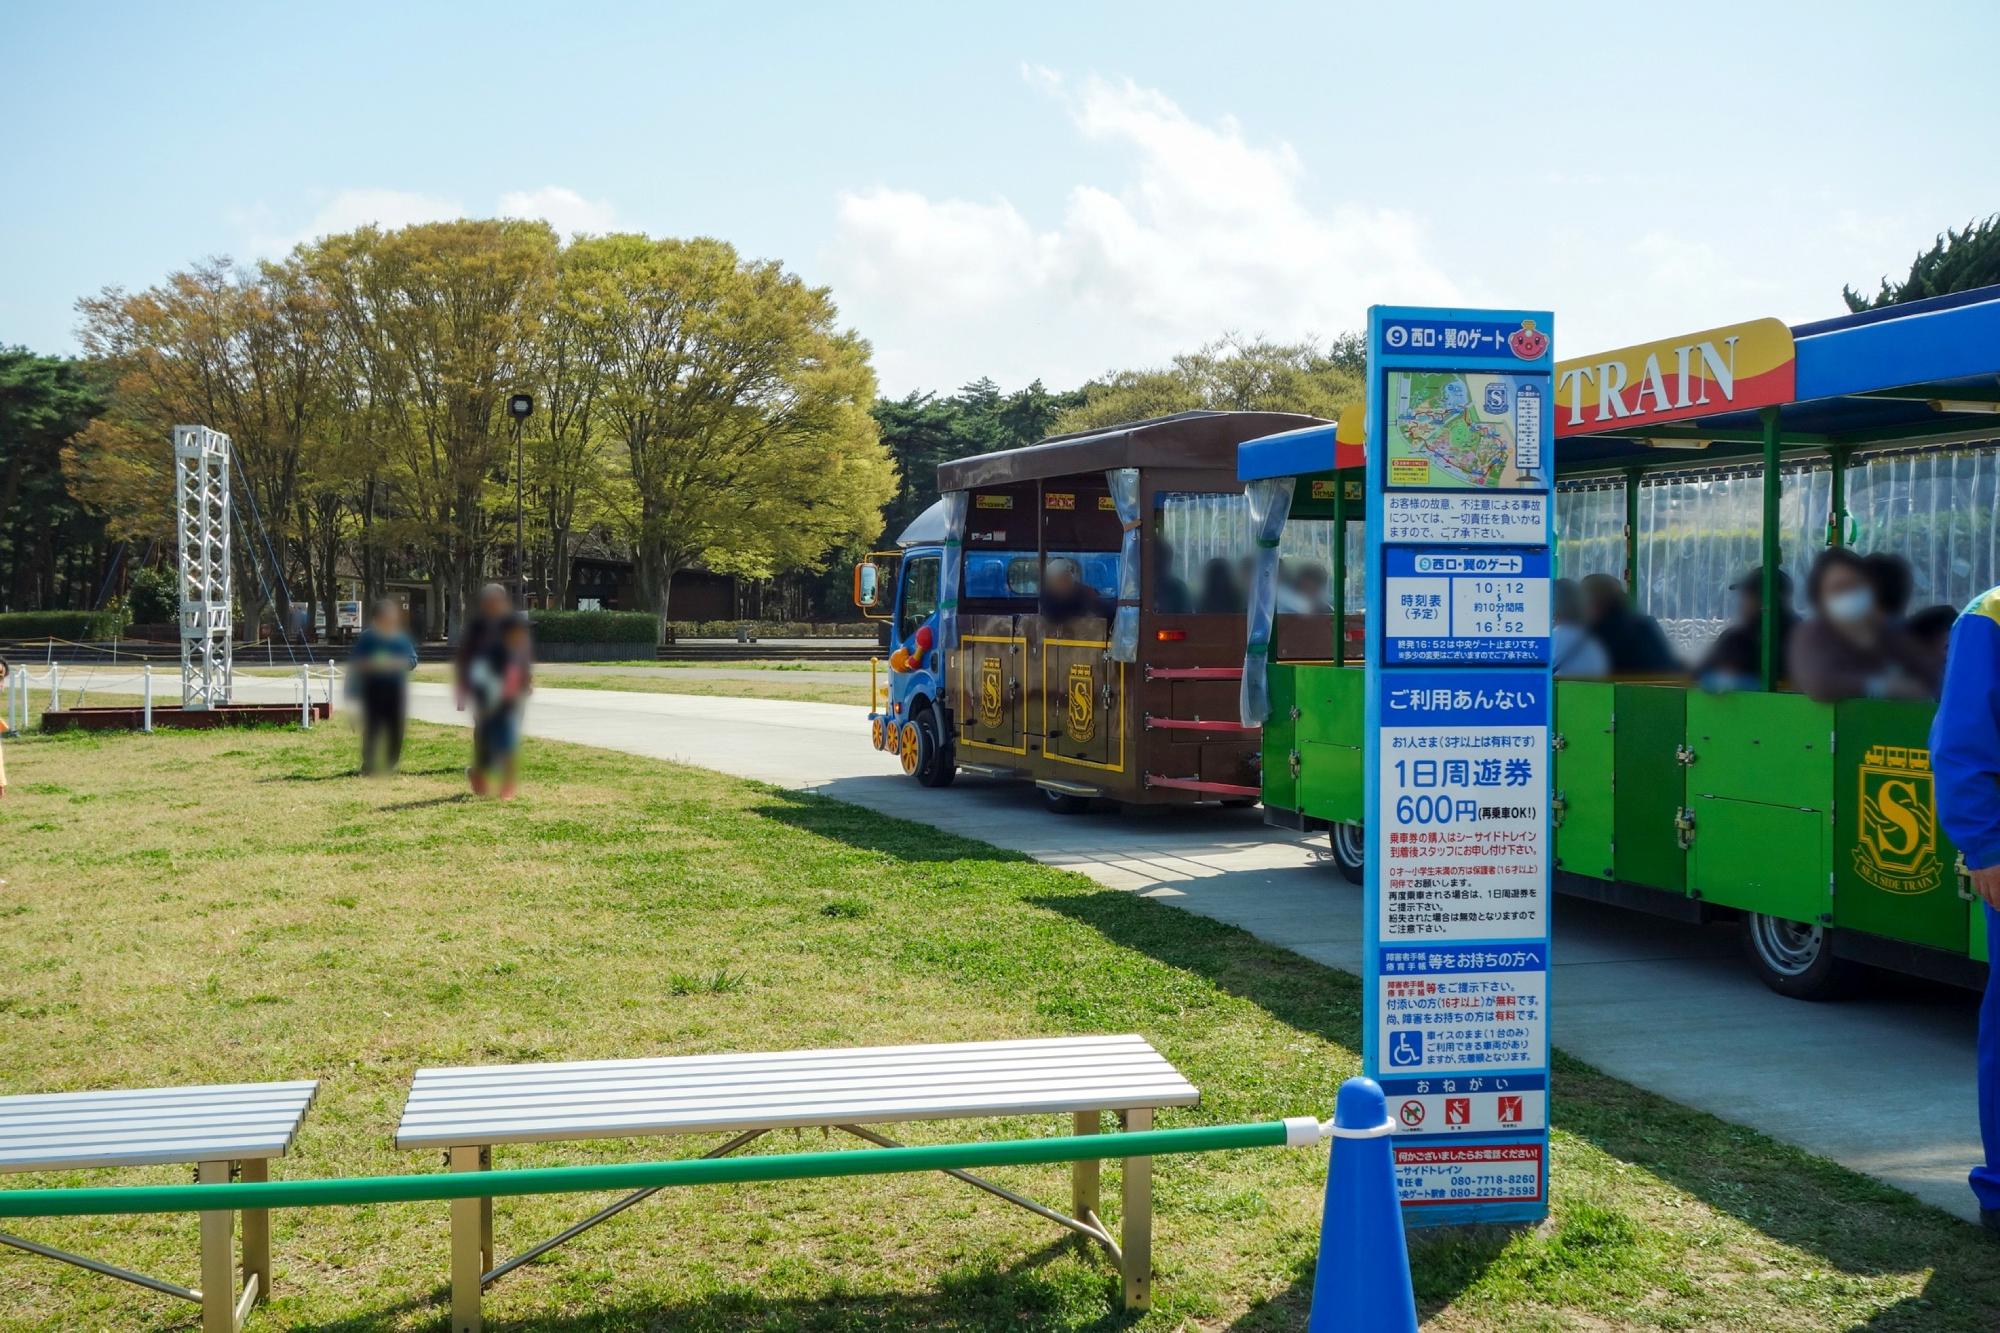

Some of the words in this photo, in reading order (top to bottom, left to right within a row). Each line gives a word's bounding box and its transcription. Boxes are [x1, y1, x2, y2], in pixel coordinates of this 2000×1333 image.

[1558, 335, 1740, 427] TRAIN
[1389, 497, 1541, 511] お客様の故意、不注意による事故
[1389, 512, 1541, 525] については、一切責任を負いかね
[1389, 526, 1506, 541] ますので、ご了承下さい。
[1475, 583, 1524, 594] 10:12
[1400, 594, 1442, 607] 時刻表
[1404, 608, 1439, 620] (予定)
[1473, 603, 1525, 613] 約10分間隔
[1475, 622, 1524, 633] 16:52
[1389, 688, 1536, 711] ご利用あんない
[1394, 758, 1533, 788] 1日周遊券
[1396, 794, 1478, 825] 600円
[1877, 779, 1920, 856] S
[1389, 831, 1537, 845] 乗車券の購入はシーサイドトレイン
[1389, 845, 1538, 858] 到着後スタッフにお申し付け下さい。
[1388, 889, 1537, 900] 再度乗車される場合は、1日周遊券を
[1388, 902, 1445, 912] ご提示下さい。
[1388, 911, 1536, 923] 紛失された場合は無効となりますので
[1388, 924, 1447, 934] ご注意下さい。
[1428, 951, 1540, 969] 等をお持ちの方へ
[1426, 982, 1516, 995] 等をご提示下さい。
[1386, 1010, 1538, 1025] 尚、障害をお持ちの方は有料です。
[1426, 1040, 1529, 1052] ご利用できる車両があり
[1426, 1053, 1531, 1064] ますが、先着順となります。
[1416, 1078, 1509, 1093] おねがい
[1395, 1165, 1463, 1176] ーサイドトレイン
[1450, 1174, 1536, 1186] 080-7718-8260
[1450, 1186, 1536, 1198] 080-2276-2598
